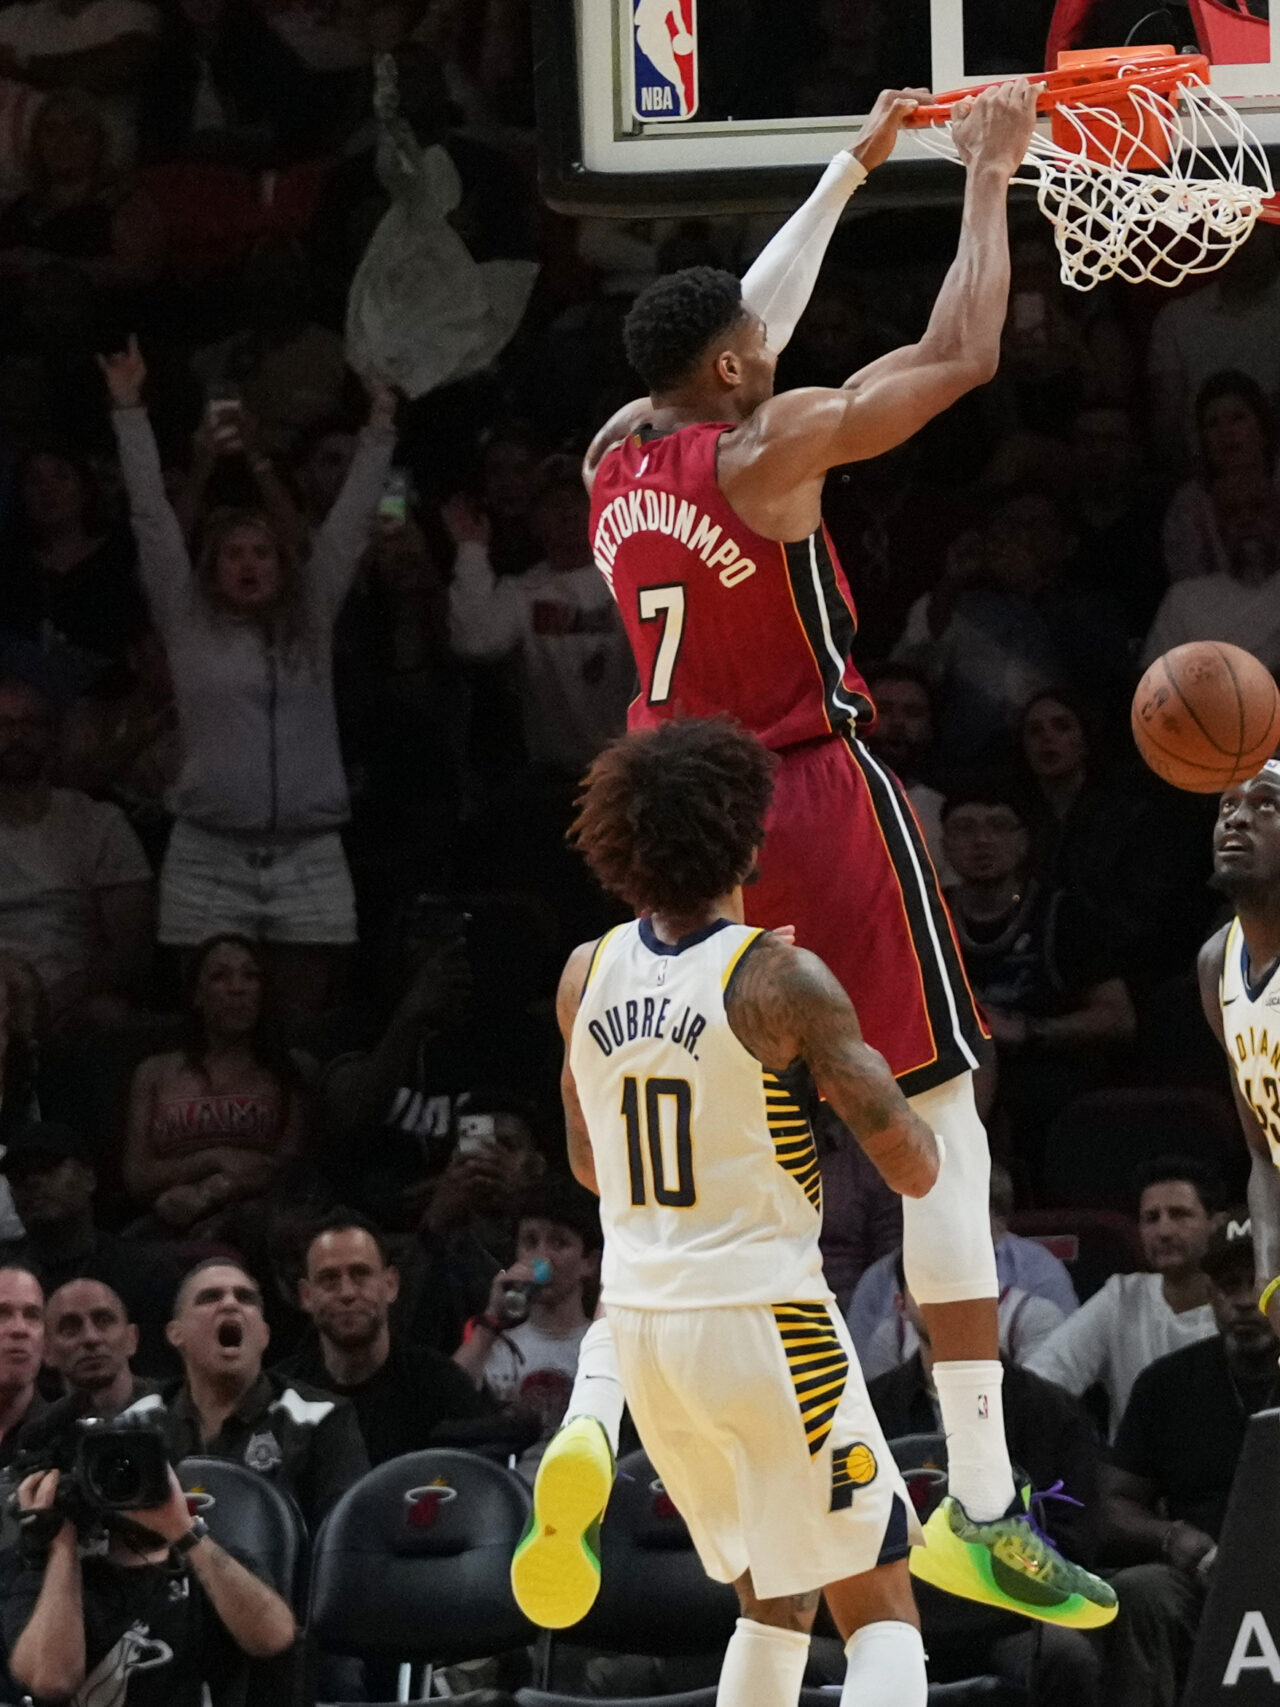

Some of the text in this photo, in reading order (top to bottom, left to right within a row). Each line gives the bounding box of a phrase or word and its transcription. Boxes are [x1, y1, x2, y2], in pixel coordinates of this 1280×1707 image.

[641, 86, 673, 111] NBA
[593, 488, 757, 602] NTETOKOUNMPO
[638, 585, 685, 702] 7
[588, 997, 706, 1062] OUBRE JR.
[621, 1076, 696, 1208] 10
